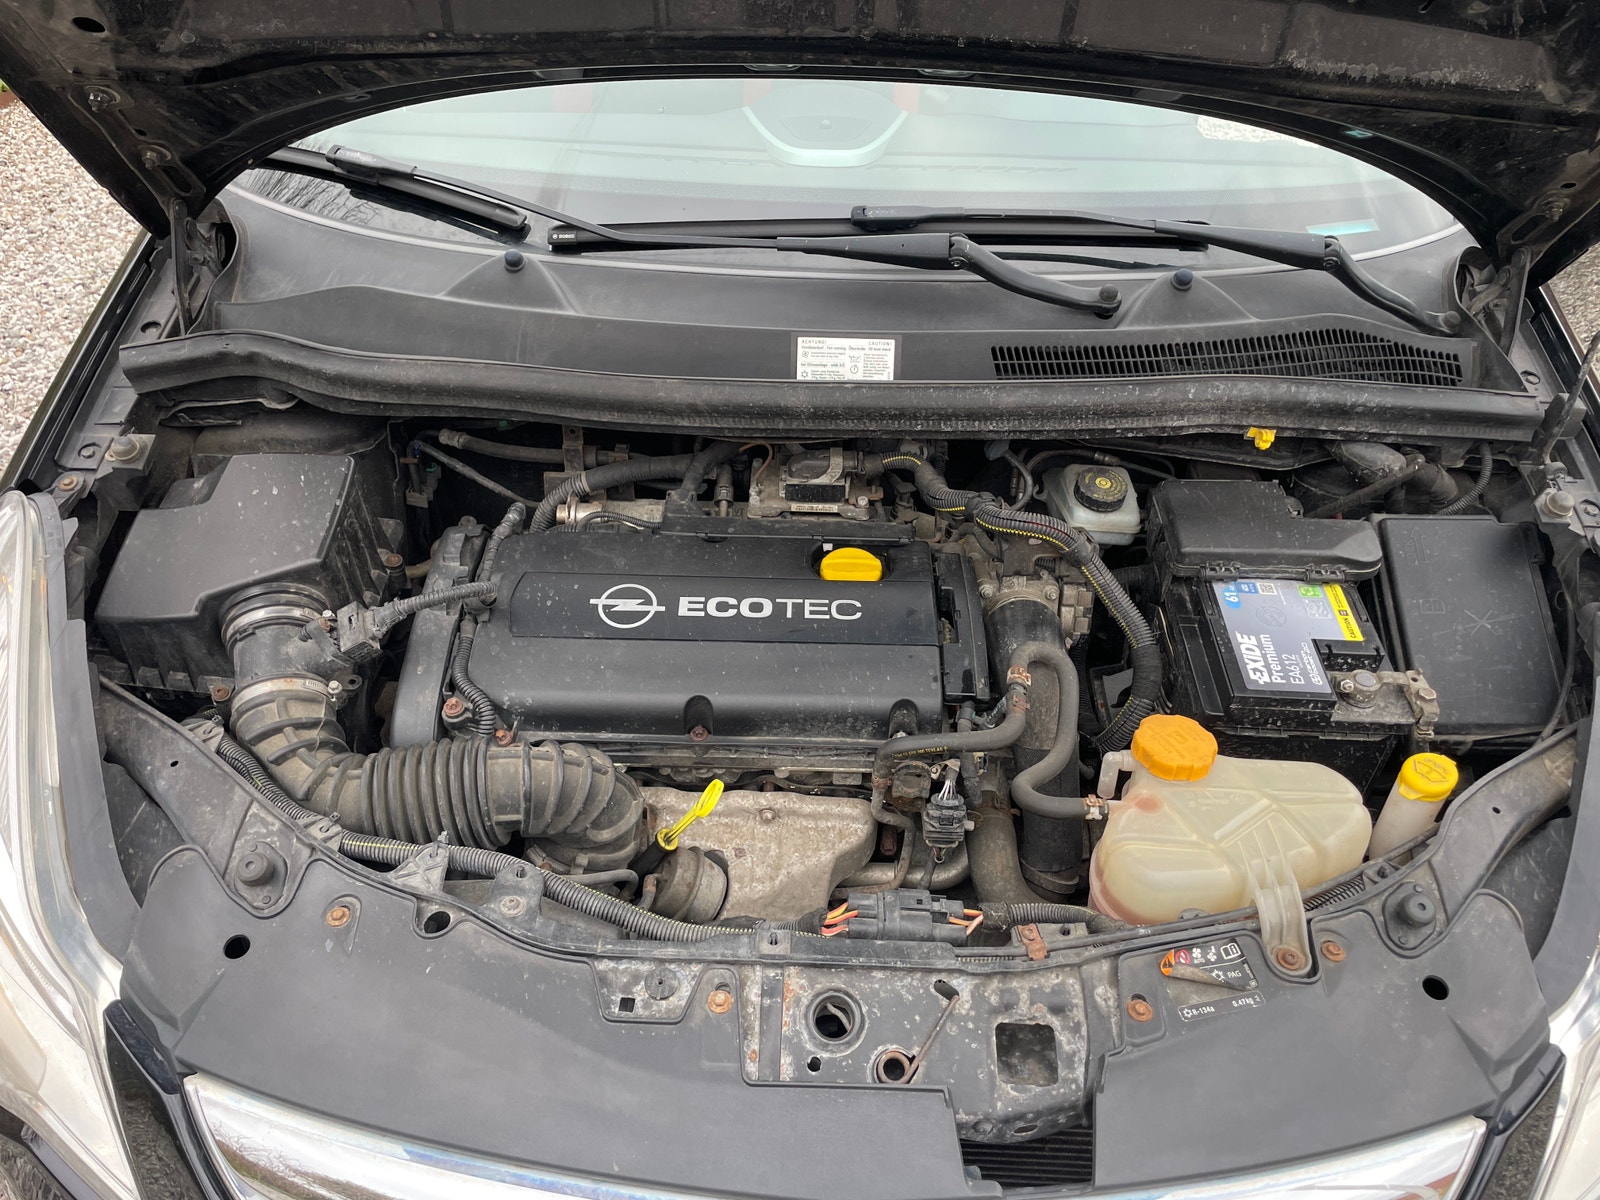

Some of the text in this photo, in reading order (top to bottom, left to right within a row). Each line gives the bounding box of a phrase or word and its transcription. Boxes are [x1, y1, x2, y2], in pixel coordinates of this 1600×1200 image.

[677, 596, 863, 621] ECOTEC
[1224, 591, 1239, 602] 61
[1236, 631, 1270, 685] EXIDE
[1259, 634, 1287, 684] Premium
[1286, 653, 1305, 685] EA612
[1226, 970, 1242, 979] PAG
[1191, 1005, 1216, 1016] R-134a
